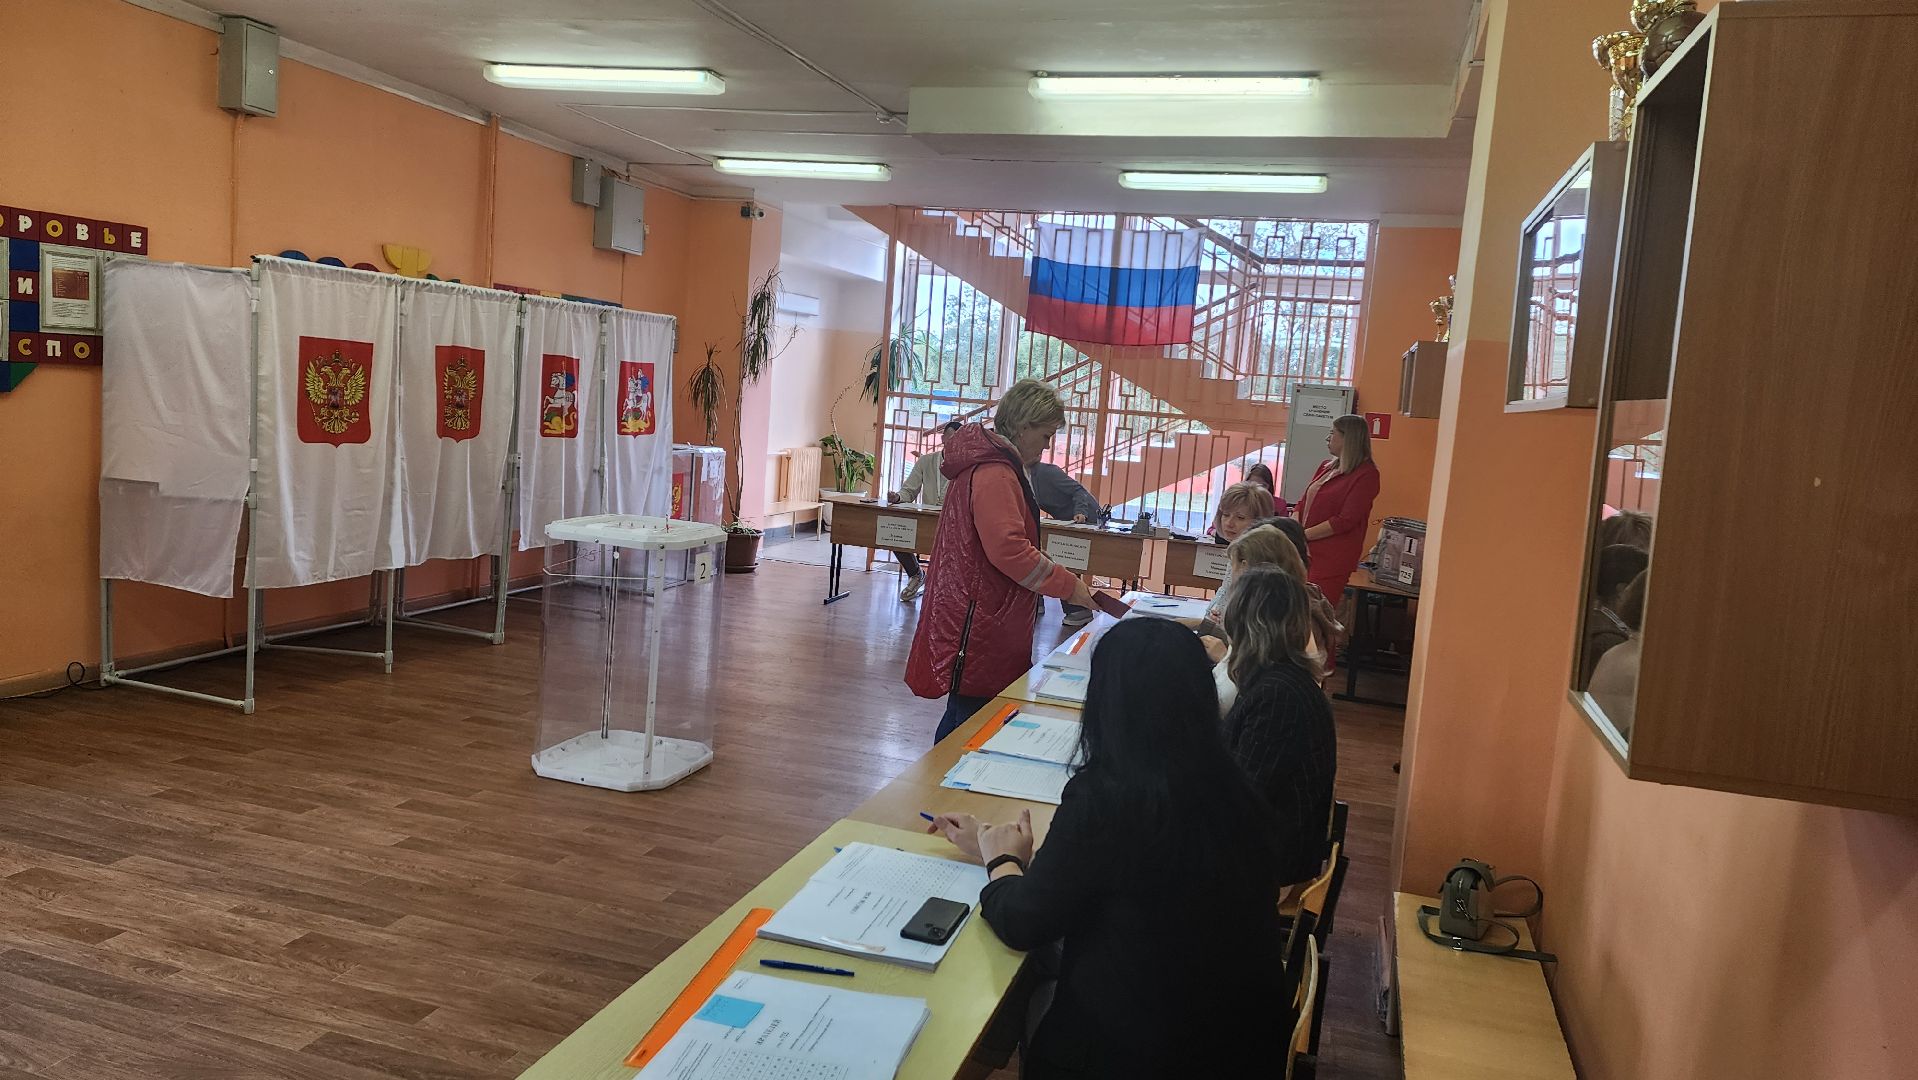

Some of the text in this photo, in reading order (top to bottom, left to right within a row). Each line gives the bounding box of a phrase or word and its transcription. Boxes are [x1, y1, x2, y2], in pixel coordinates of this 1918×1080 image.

[0, 213, 142, 248] РОВЬЕ
[18, 276, 34, 295] И
[1405, 538, 1413, 553] 1
[700, 562, 706, 579] 2
